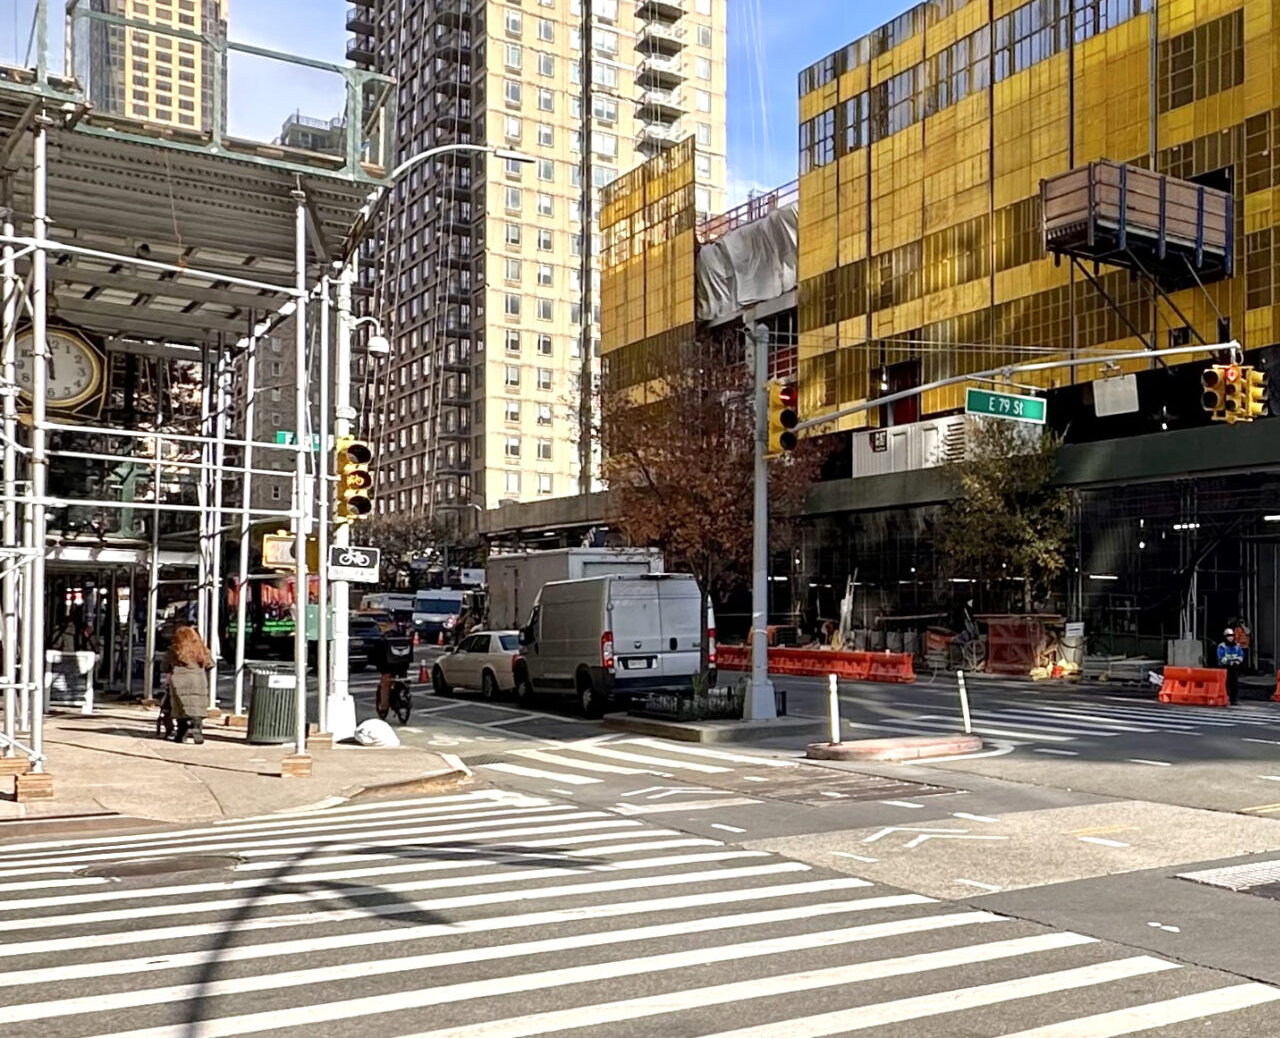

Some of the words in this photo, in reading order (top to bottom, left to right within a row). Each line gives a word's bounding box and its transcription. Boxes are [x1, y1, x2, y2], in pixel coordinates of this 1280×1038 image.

[989, 397, 996, 411] E
[999, 398, 1010, 413] 79
[1013, 400, 1024, 415] St
